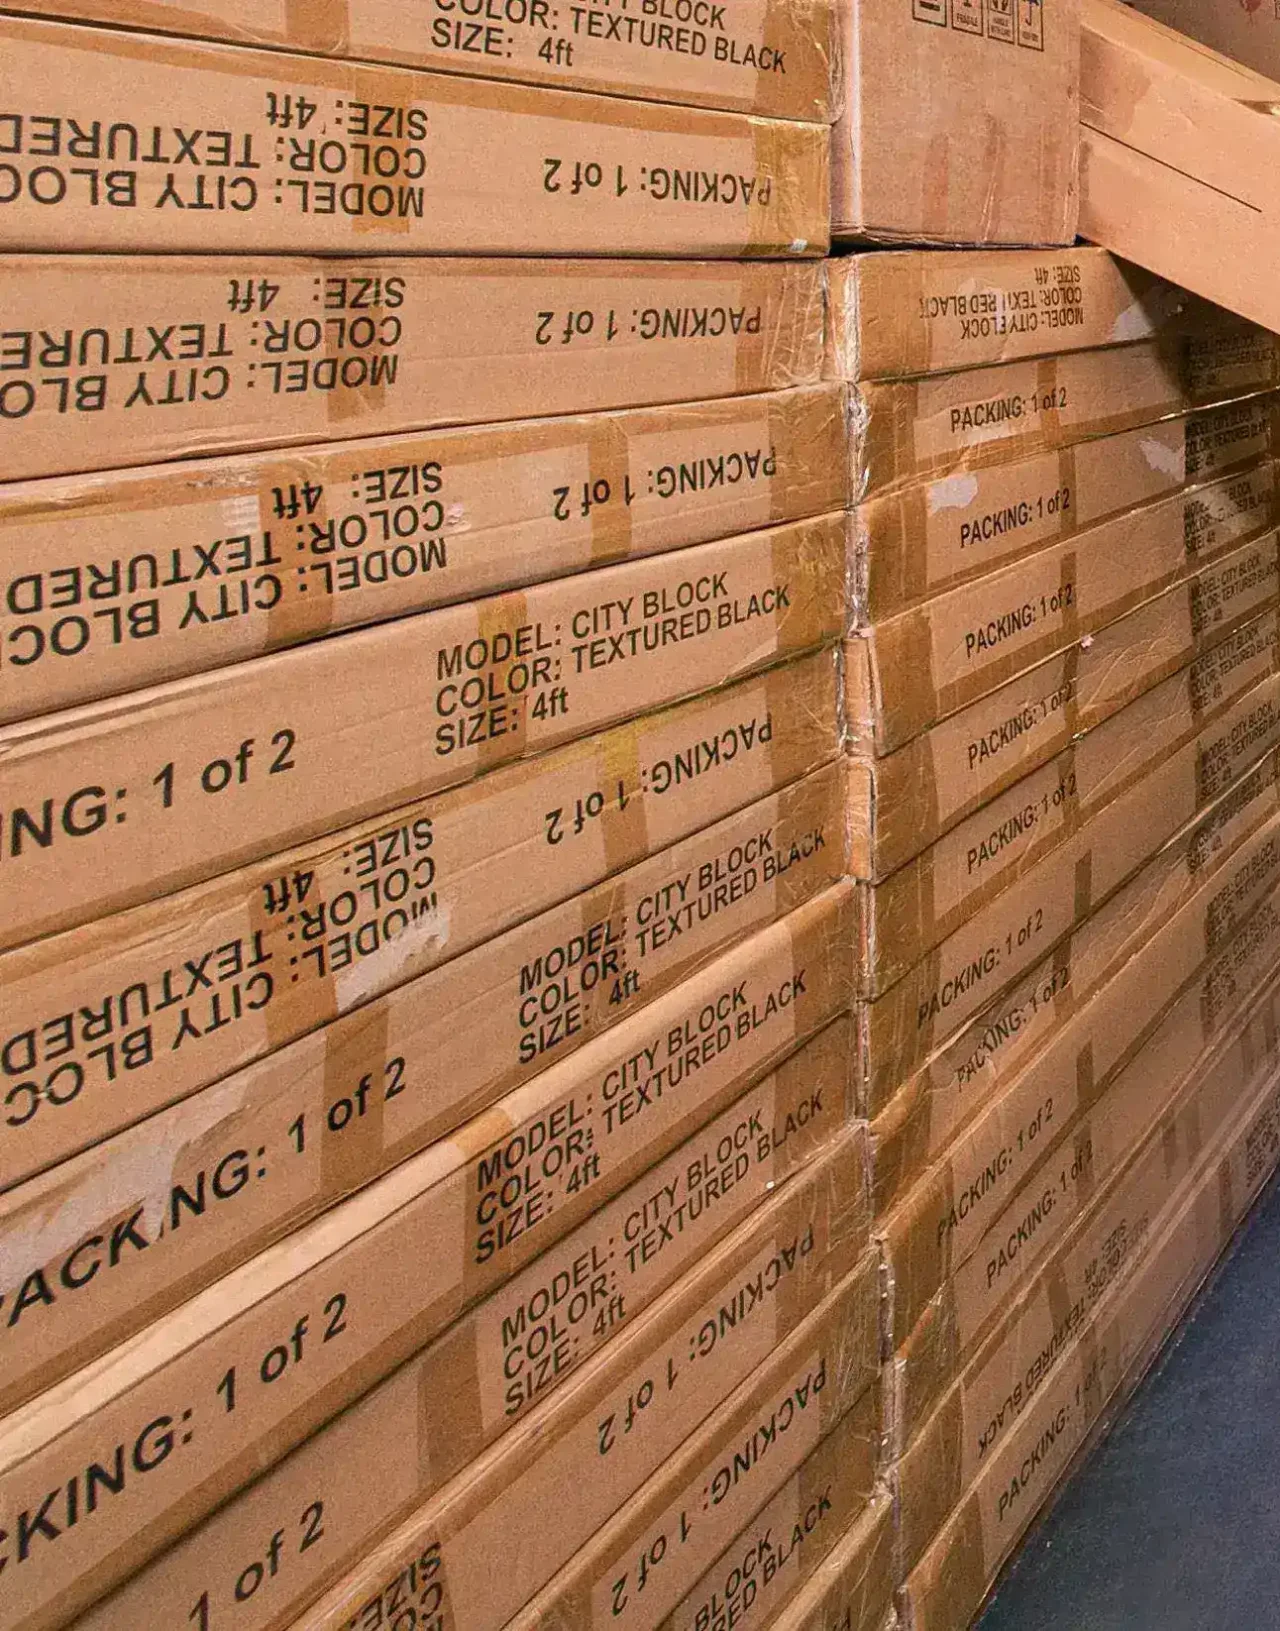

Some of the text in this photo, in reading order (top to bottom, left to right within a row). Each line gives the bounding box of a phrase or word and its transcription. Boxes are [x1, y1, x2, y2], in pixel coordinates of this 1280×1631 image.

[430, 17, 574, 67] SIZE: 4ft
[571, 7, 706, 56] TEXTURED
[714, 36, 788, 74] BLACK
[266, 91, 429, 141] SIZE: 4ft
[154, 172, 258, 212] CITY
[276, 135, 427, 179] COLOR:
[543, 158, 771, 206] PACKING: 1 of 2
[274, 177, 425, 218] MODEL:
[227, 276, 407, 313] SIZE: 4ft
[1035, 266, 1081, 285] SIZE: 4ft
[1040, 287, 1081, 306] COLOR:
[250, 316, 401, 353] COLOR:
[535, 306, 760, 345] PACKING: 1 of 2
[1010, 314, 1037, 333] CITY
[1042, 308, 1084, 329] MODEL:
[124, 365, 230, 408] CITY
[247, 354, 399, 394] MODEL:
[950, 386, 1067, 433] PACKING: 1 of 2
[273, 461, 442, 520] SIZE: 4ft
[553, 446, 777, 521] PACKING: 1 of 2
[960, 488, 1070, 548] PACKING: 1 of 2
[6, 499, 445, 616] COLOR: TEXTURED
[299, 537, 448, 594] MODEL:
[179, 573, 282, 630] CITY
[437, 571, 729, 682] MODEL: CITY BLOCK
[965, 583, 1072, 659] PACKING: 1 of 2
[436, 583, 791, 718] COLOR: TEXTURED BLACK
[435, 688, 570, 756] SIZE: 4ft
[968, 690, 1065, 770] PACKING: 1 of
[153, 762, 174, 809] 1
[200, 738, 254, 793] of
[269, 728, 295, 774] 2
[545, 713, 773, 845] PACKING: 1 of 2
[967, 773, 1076, 875] PACKING: 1 of 2
[263, 817, 434, 914] SIZE: 4ft
[518, 829, 774, 995] MODEL: CITY BLOCK
[518, 825, 826, 1029] COLOR: TEXTURED BLACK
[1, 856, 436, 1076] COLOR: TEXTURED
[917, 908, 1043, 1029] PACKING: 1 of 2
[172, 971, 274, 1051] CITY
[518, 970, 640, 1065] SIZE: 4ft
[475, 969, 807, 1226] COLOR: TEXTURED BLACK
[476, 980, 748, 1193] MODEL: CITY BLOCK
[0, 1056, 406, 1328] ACKNG: 1 of 2
[474, 1154, 600, 1265] SIZE: 4ft
[936, 1098, 1053, 1248] PACKING: 1 of 2
[502, 1108, 765, 1348] MODEL: CITY BLOCK
[503, 1089, 824, 1379] COLOR: TEXTURED BLACK
[986, 1140, 1093, 1289] PACKING: 1 of 2
[505, 1293, 626, 1415] SIZE: 4ft
[598, 1223, 815, 1456] PACKING: 1 of 2
[0, 1292, 348, 1577] KING: 1 of 2
[978, 1382, 1022, 1459] BLACK
[611, 1358, 827, 1616] PACKING: 1 of 2
[998, 1406, 1070, 1521] PACKING:
[234, 1526, 285, 1603] of
[300, 1500, 325, 1554] 2
[763, 1484, 832, 1587] BLACK
